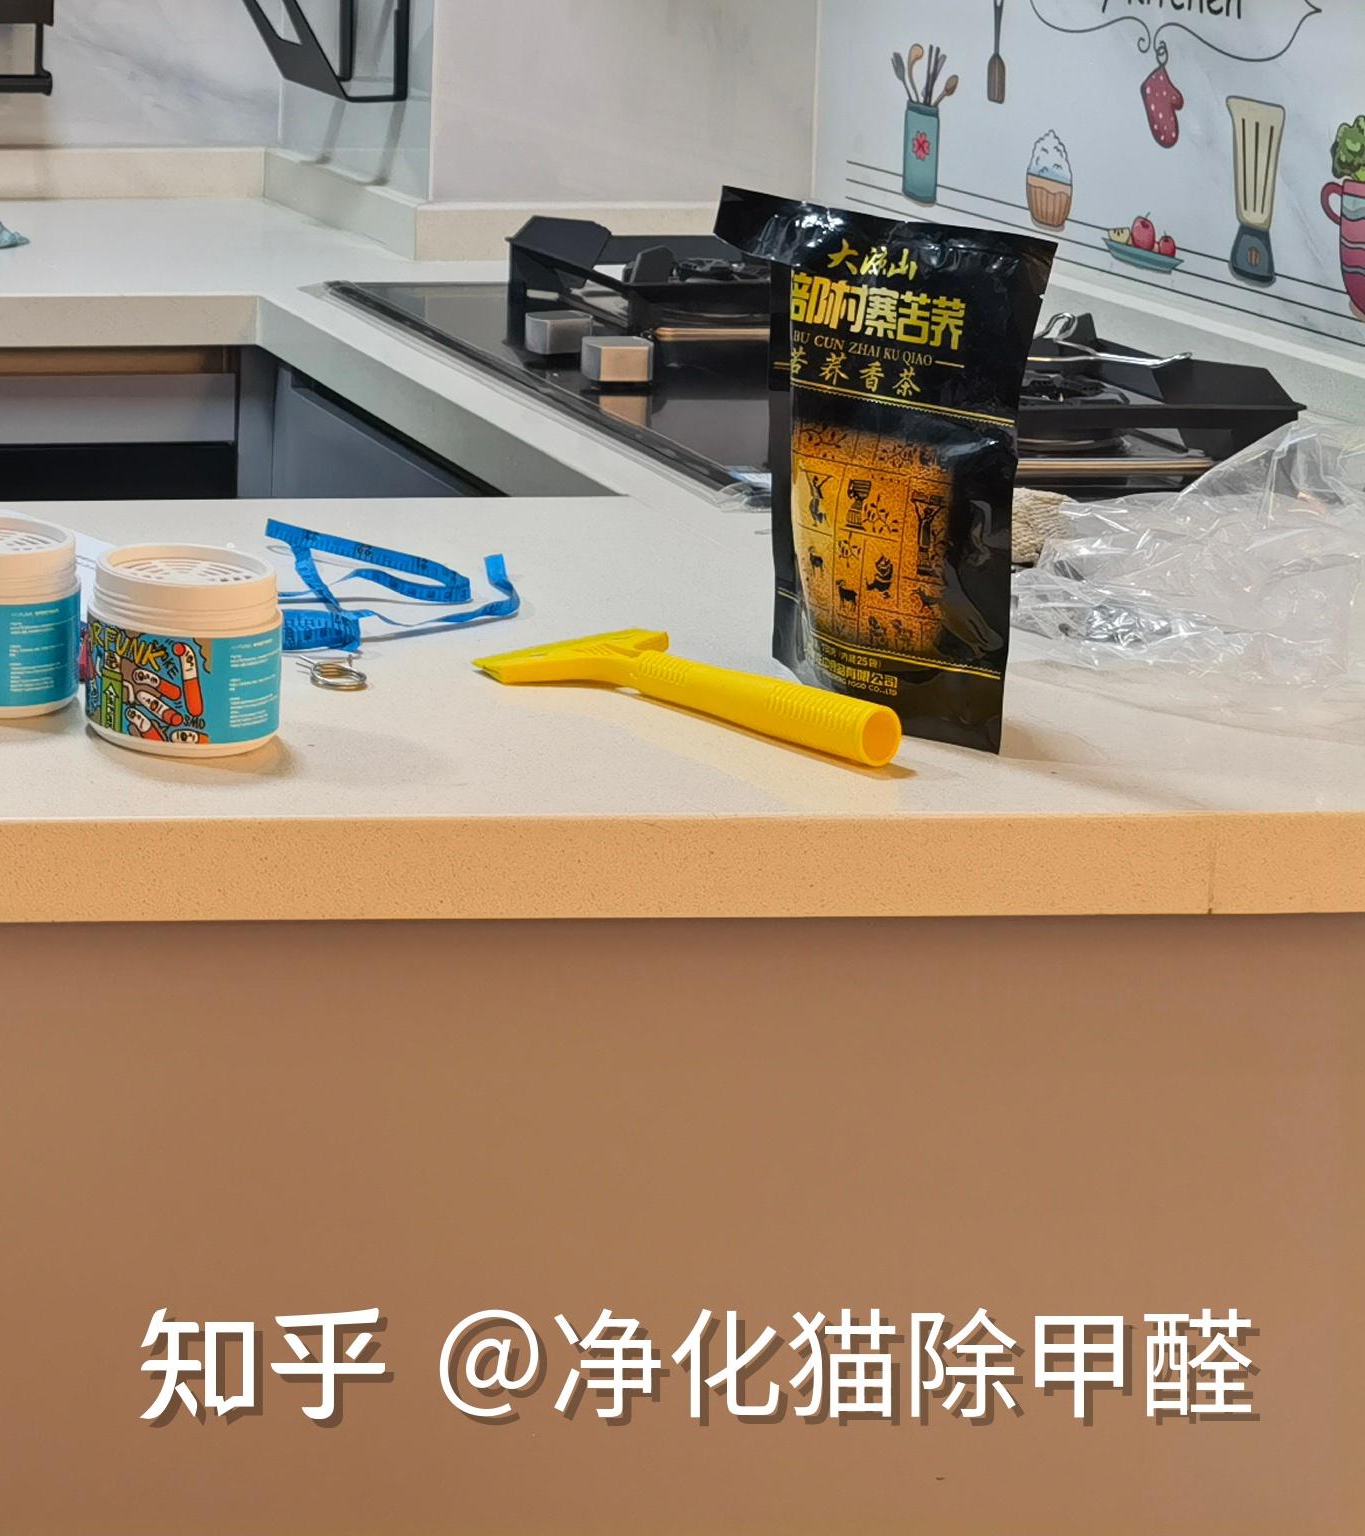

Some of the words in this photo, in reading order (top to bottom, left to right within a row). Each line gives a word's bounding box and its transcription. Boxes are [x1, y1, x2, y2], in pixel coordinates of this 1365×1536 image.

[814, 335, 845, 350] CUN
[849, 342, 880, 358] ZHAI
[883, 348, 899, 360] KU
[902, 352, 933, 367] QIAO
